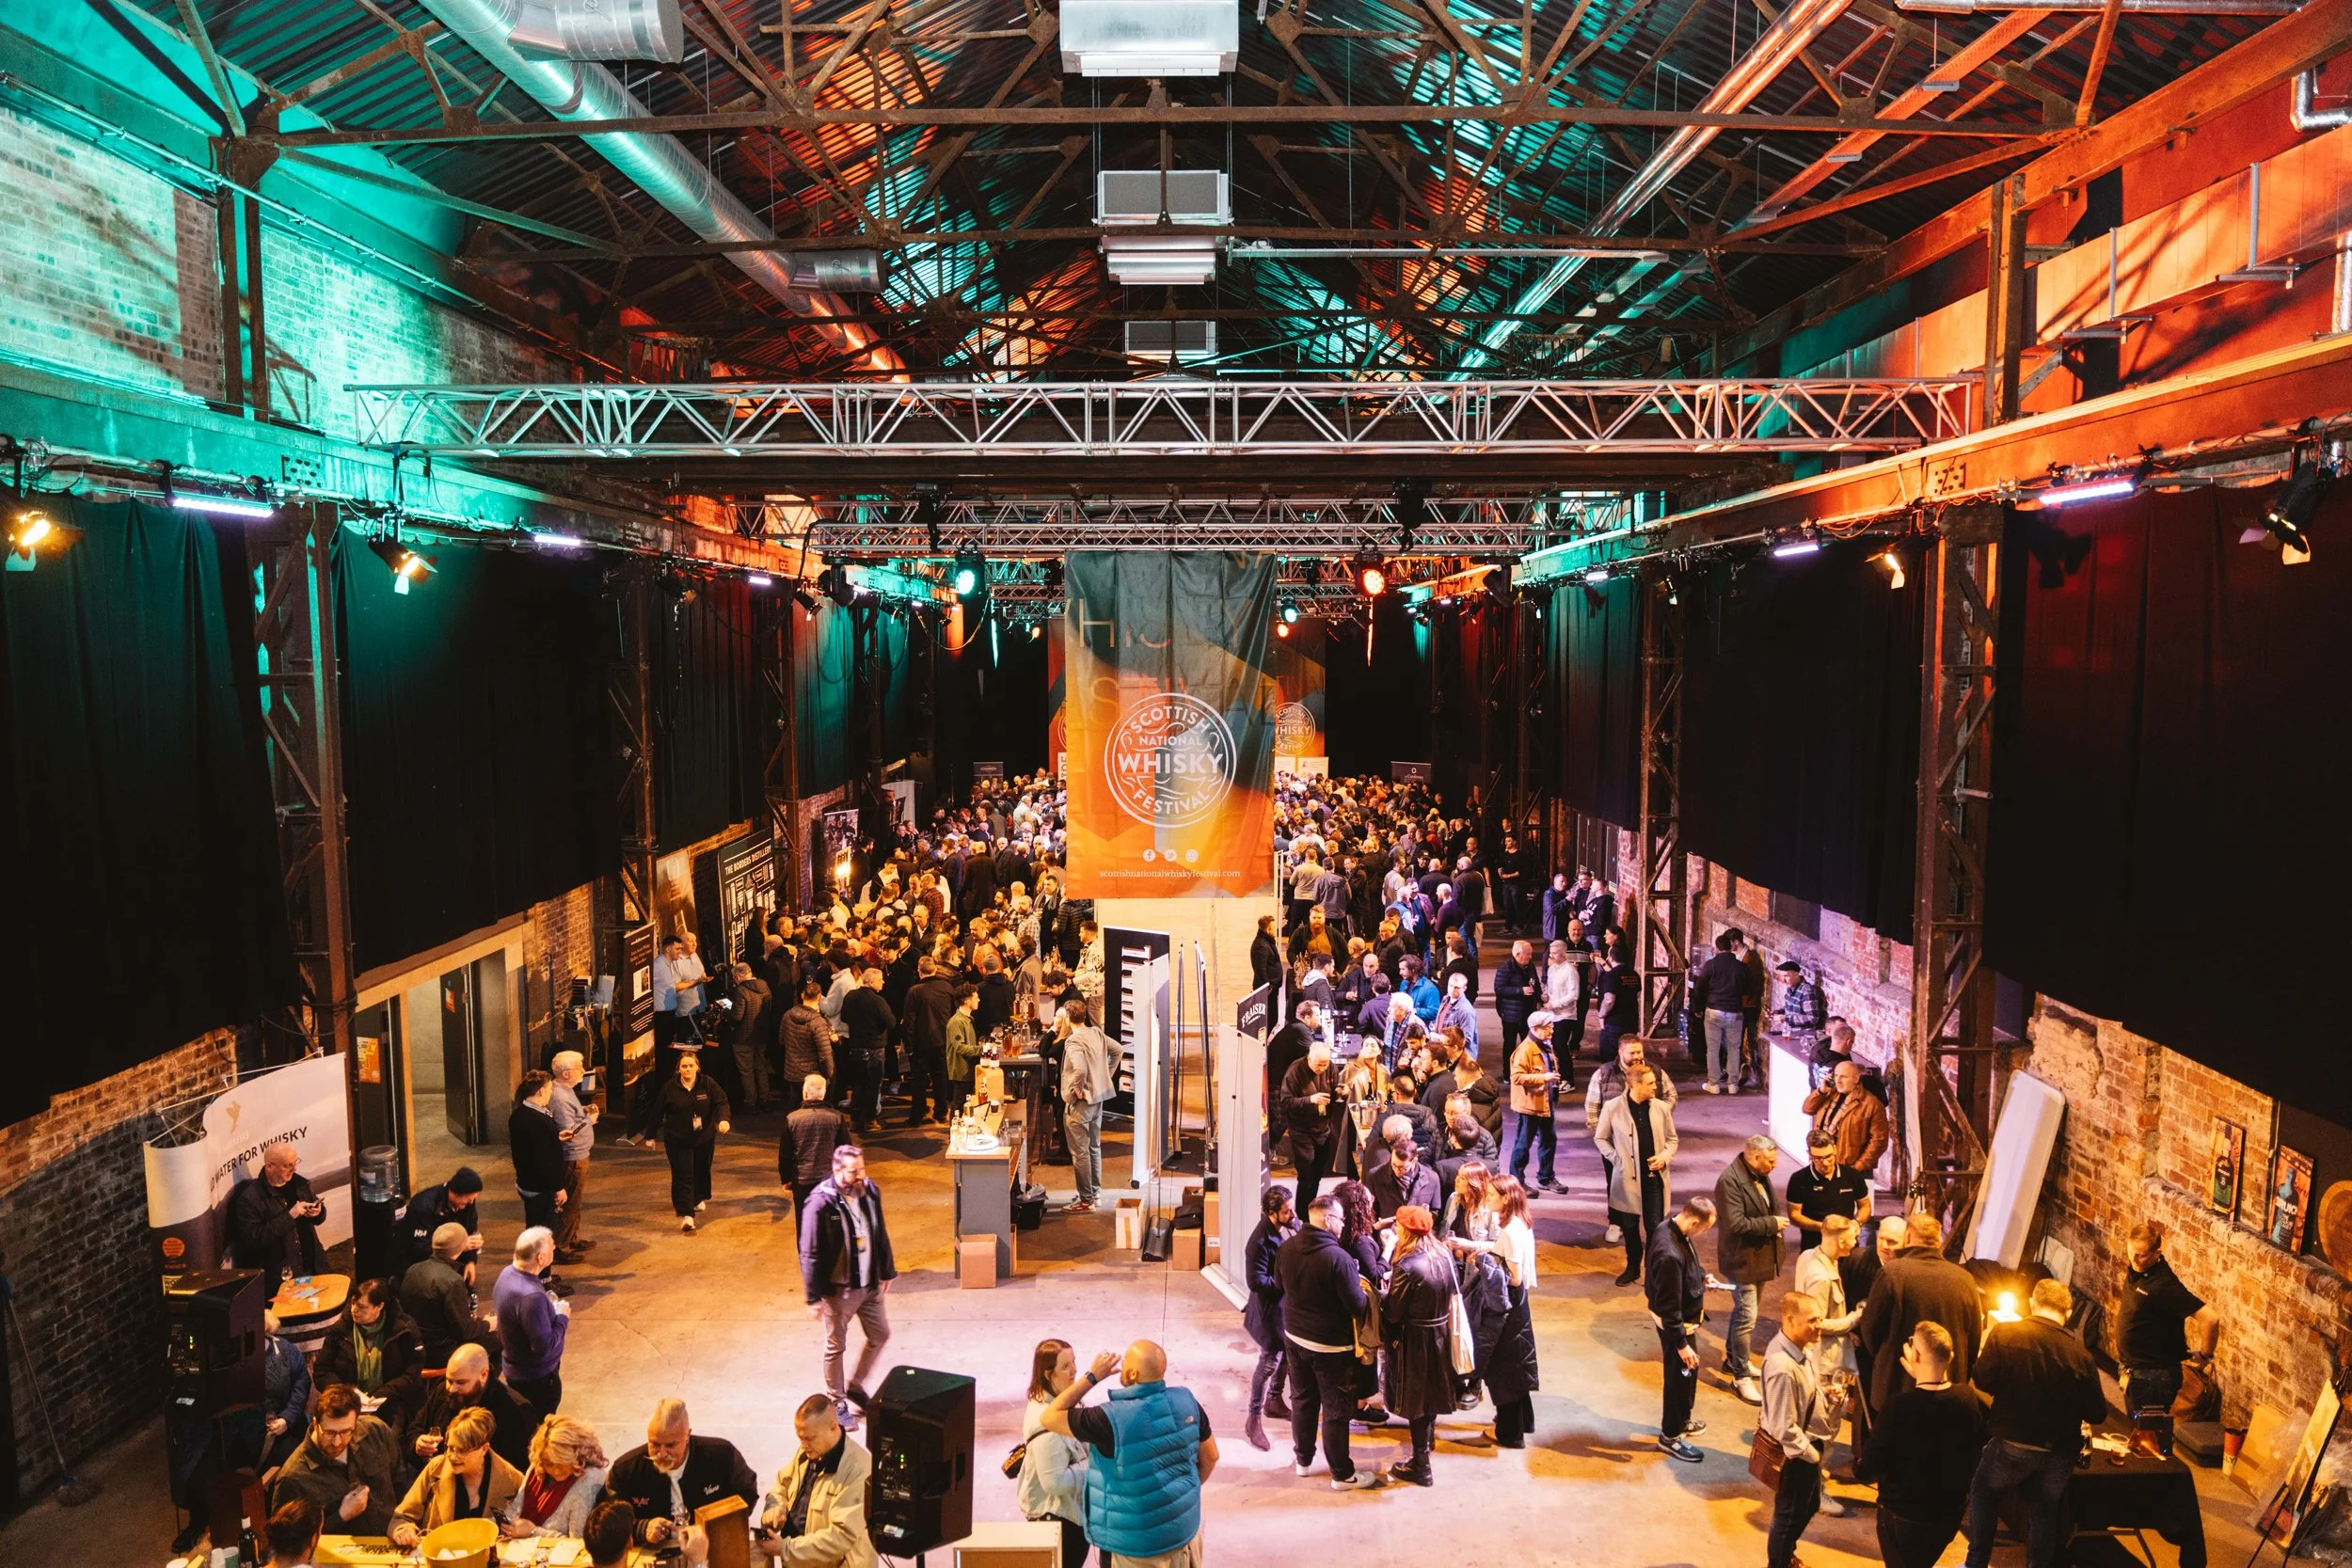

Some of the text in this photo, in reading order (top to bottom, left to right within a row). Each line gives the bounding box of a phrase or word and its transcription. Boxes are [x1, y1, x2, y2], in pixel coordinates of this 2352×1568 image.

[1130, 705, 1211, 734] SCOTTISH
[1139, 736, 1202, 746] NATIONAL
[1117, 752, 1224, 774] WHISKY
[1132, 788, 1211, 816] FESTIVAL
[1100, 869, 1241, 879] scottishnationalwhiskyfestival.com
[215, 1158, 237, 1183] WATER
[238, 1146, 258, 1166] FOR
[414, 1228, 427, 1238] HH
[703, 1484, 720, 1496] Vans
